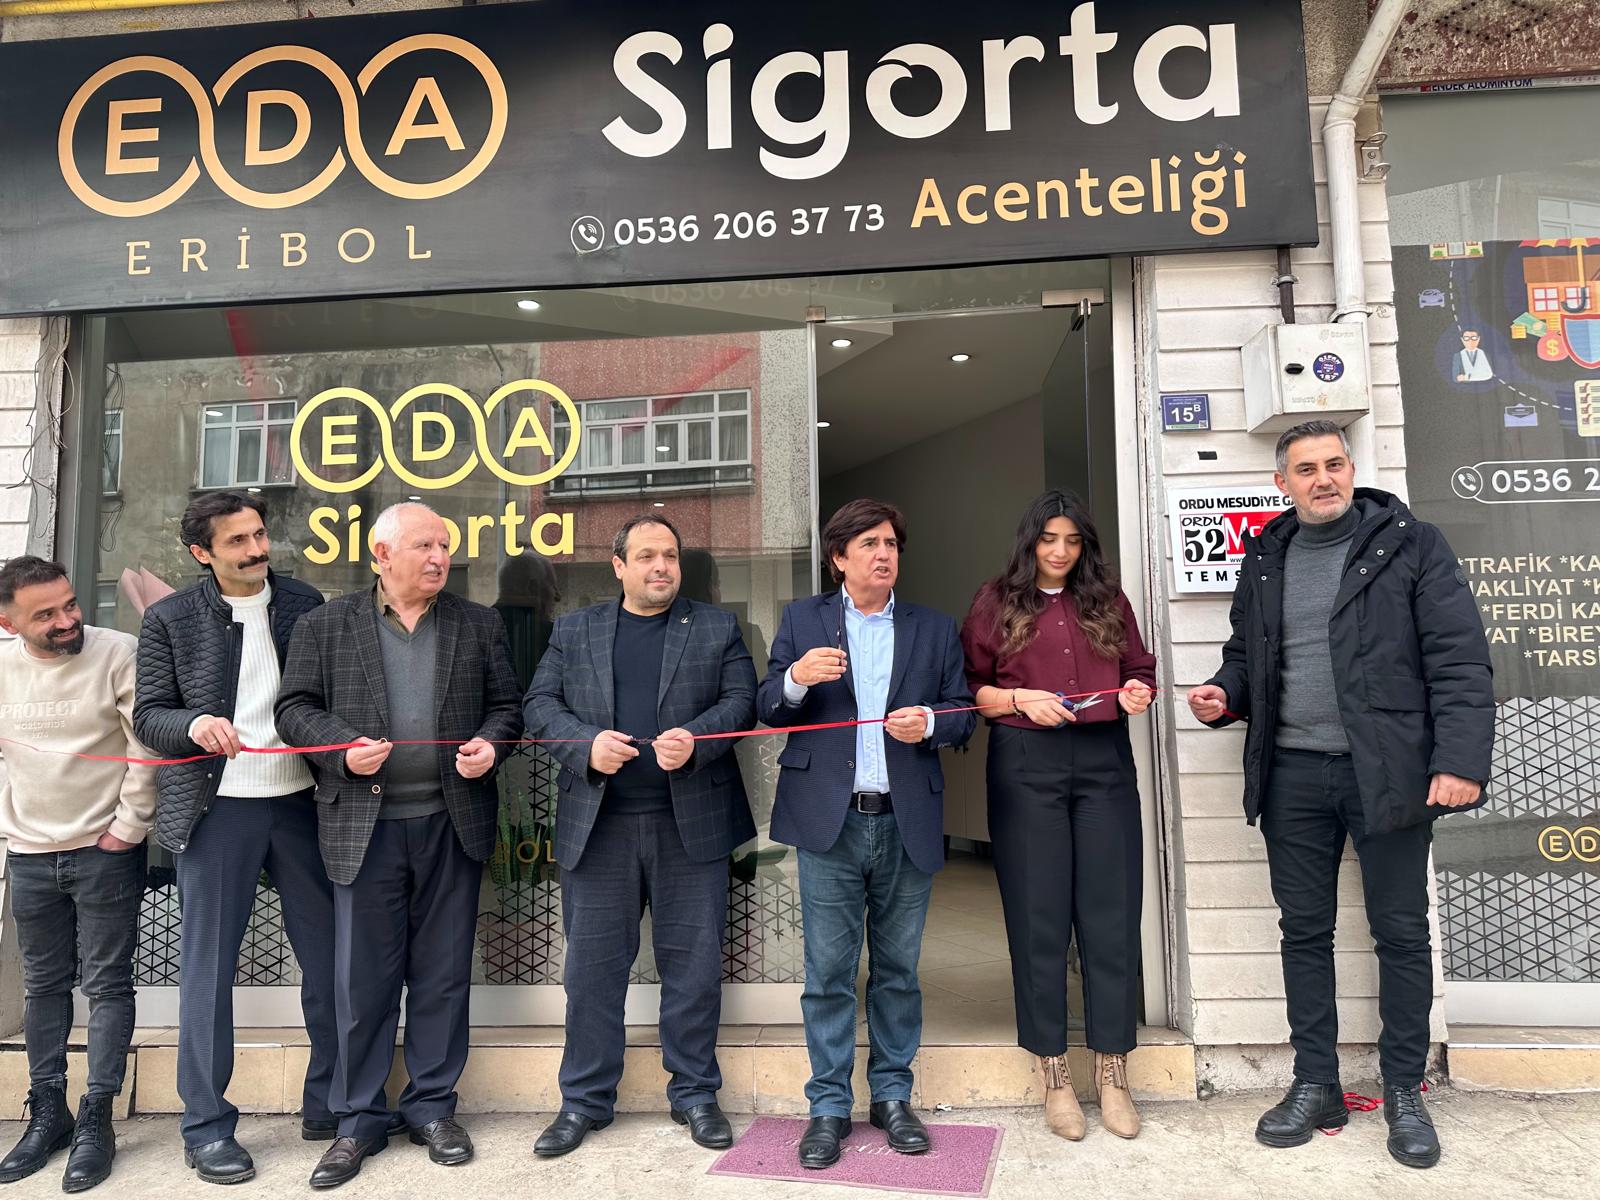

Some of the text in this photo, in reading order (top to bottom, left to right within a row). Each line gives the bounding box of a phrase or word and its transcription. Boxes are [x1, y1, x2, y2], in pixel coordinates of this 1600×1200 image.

[601, 1, 1241, 181] Sigorta
[105, 76, 465, 176] EDA
[910, 149, 1248, 237] Acenteliği
[613, 202, 886, 247] 0536 206 37 73
[126, 225, 433, 276] ERİBOL
[321, 406, 555, 466] EDA
[1179, 498, 1215, 510] ORDU
[1491, 468, 1573, 493] 0536
[302, 501, 575, 576] Sirta
[1181, 515, 1224, 527] ORDU
[1184, 528, 1227, 563] 52
[1469, 576, 1575, 597] AKLİYAT
